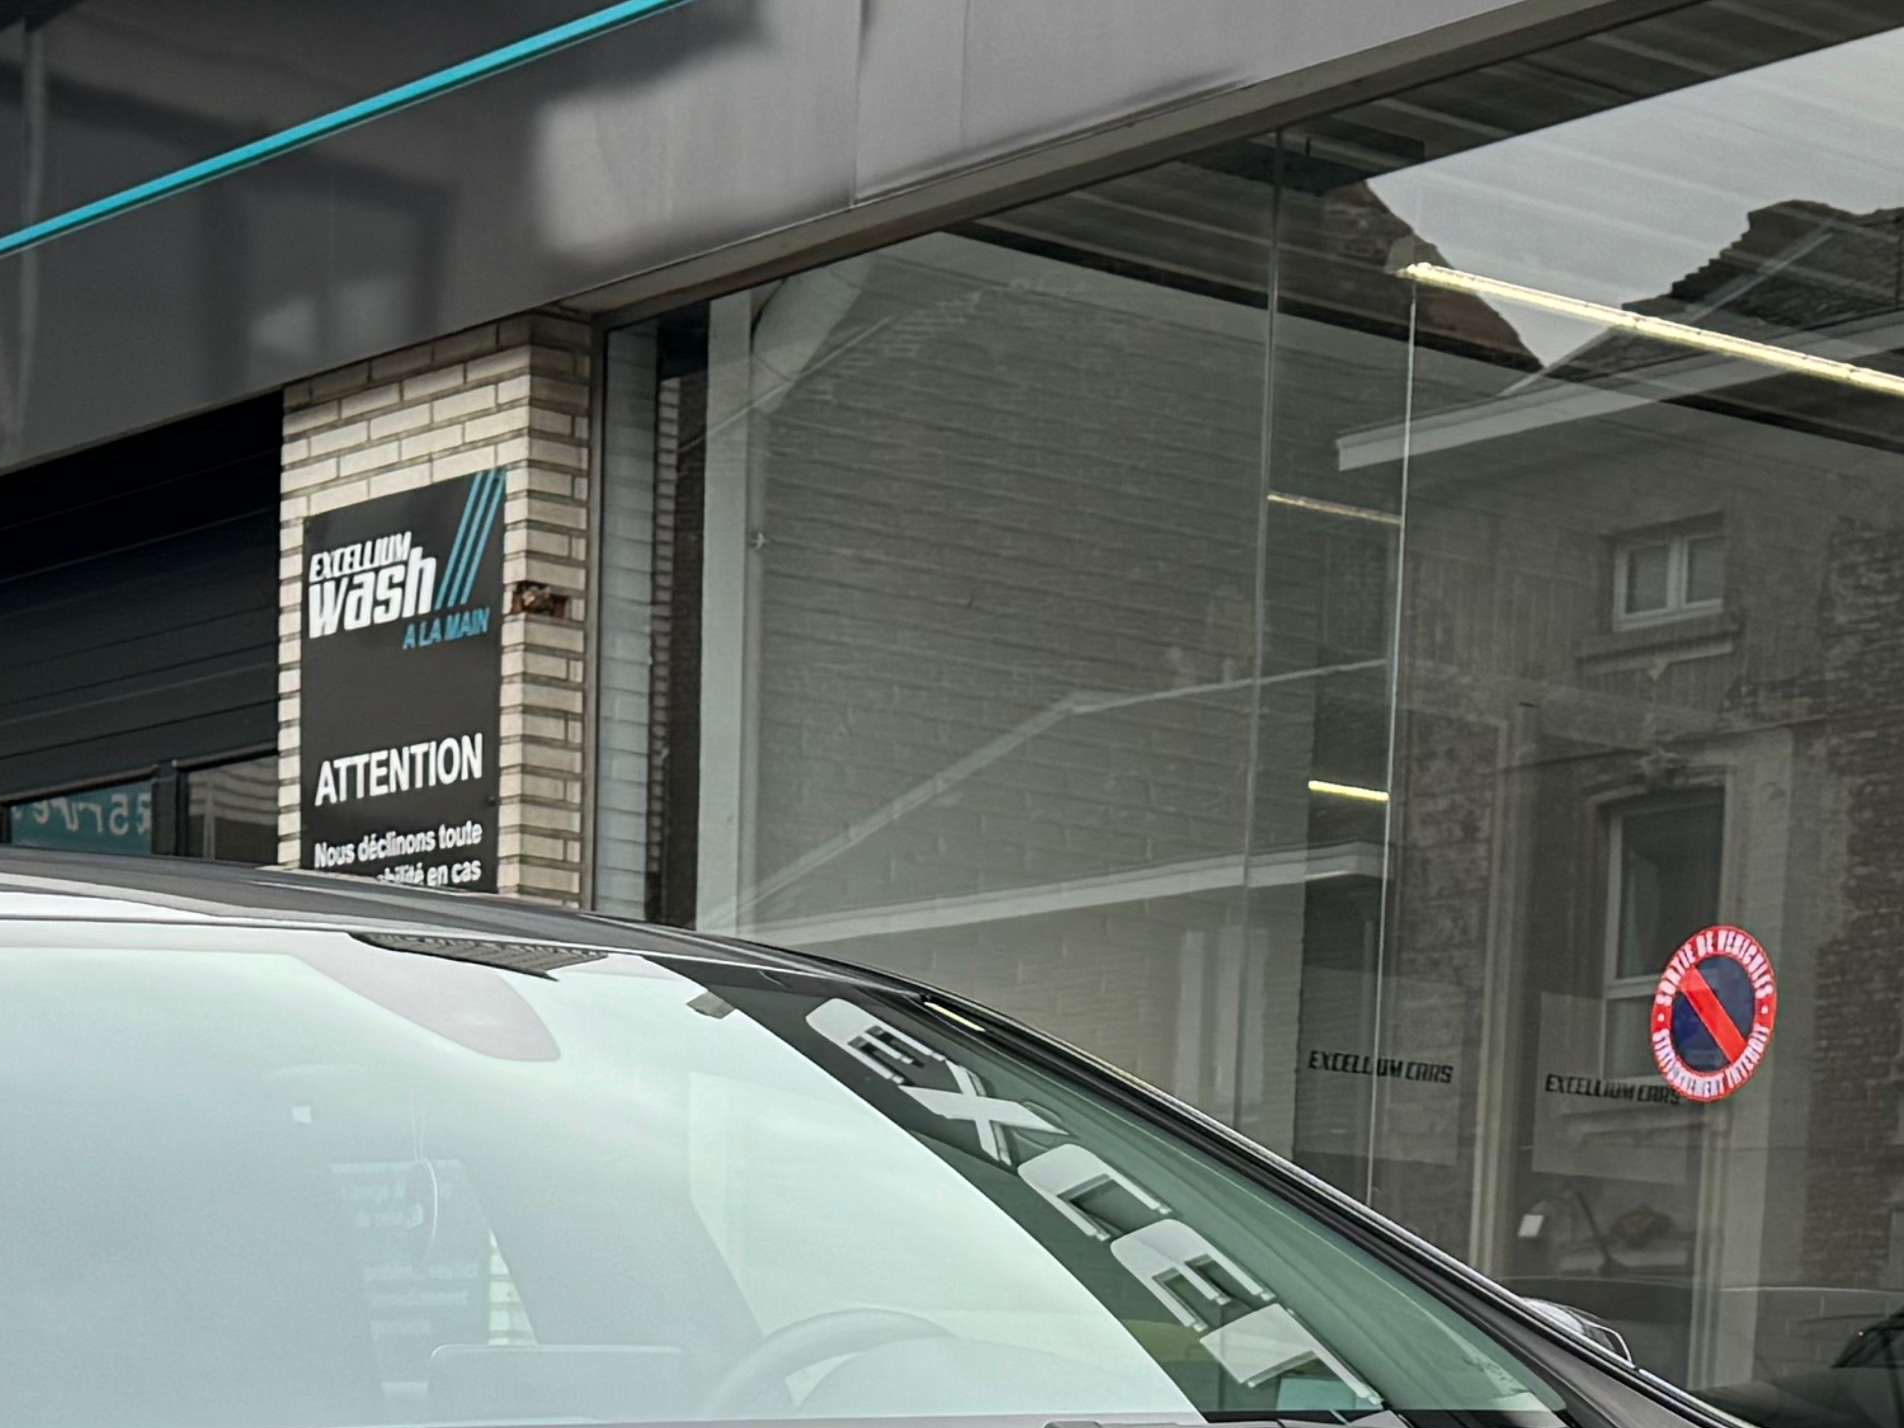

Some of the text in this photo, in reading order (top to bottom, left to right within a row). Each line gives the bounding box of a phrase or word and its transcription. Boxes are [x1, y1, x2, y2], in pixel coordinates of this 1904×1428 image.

[309, 531, 412, 583] EXCELLIUM
[308, 546, 437, 639] wash
[419, 618, 441, 647] LA
[445, 607, 490, 641] MAIN
[314, 732, 483, 806] ATTENTION
[314, 820, 483, 868] Nous déclinons toute
[427, 864, 448, 886] en
[451, 859, 482, 883] cas
[1308, 1050, 1454, 1084] EXCELLUM CARS
